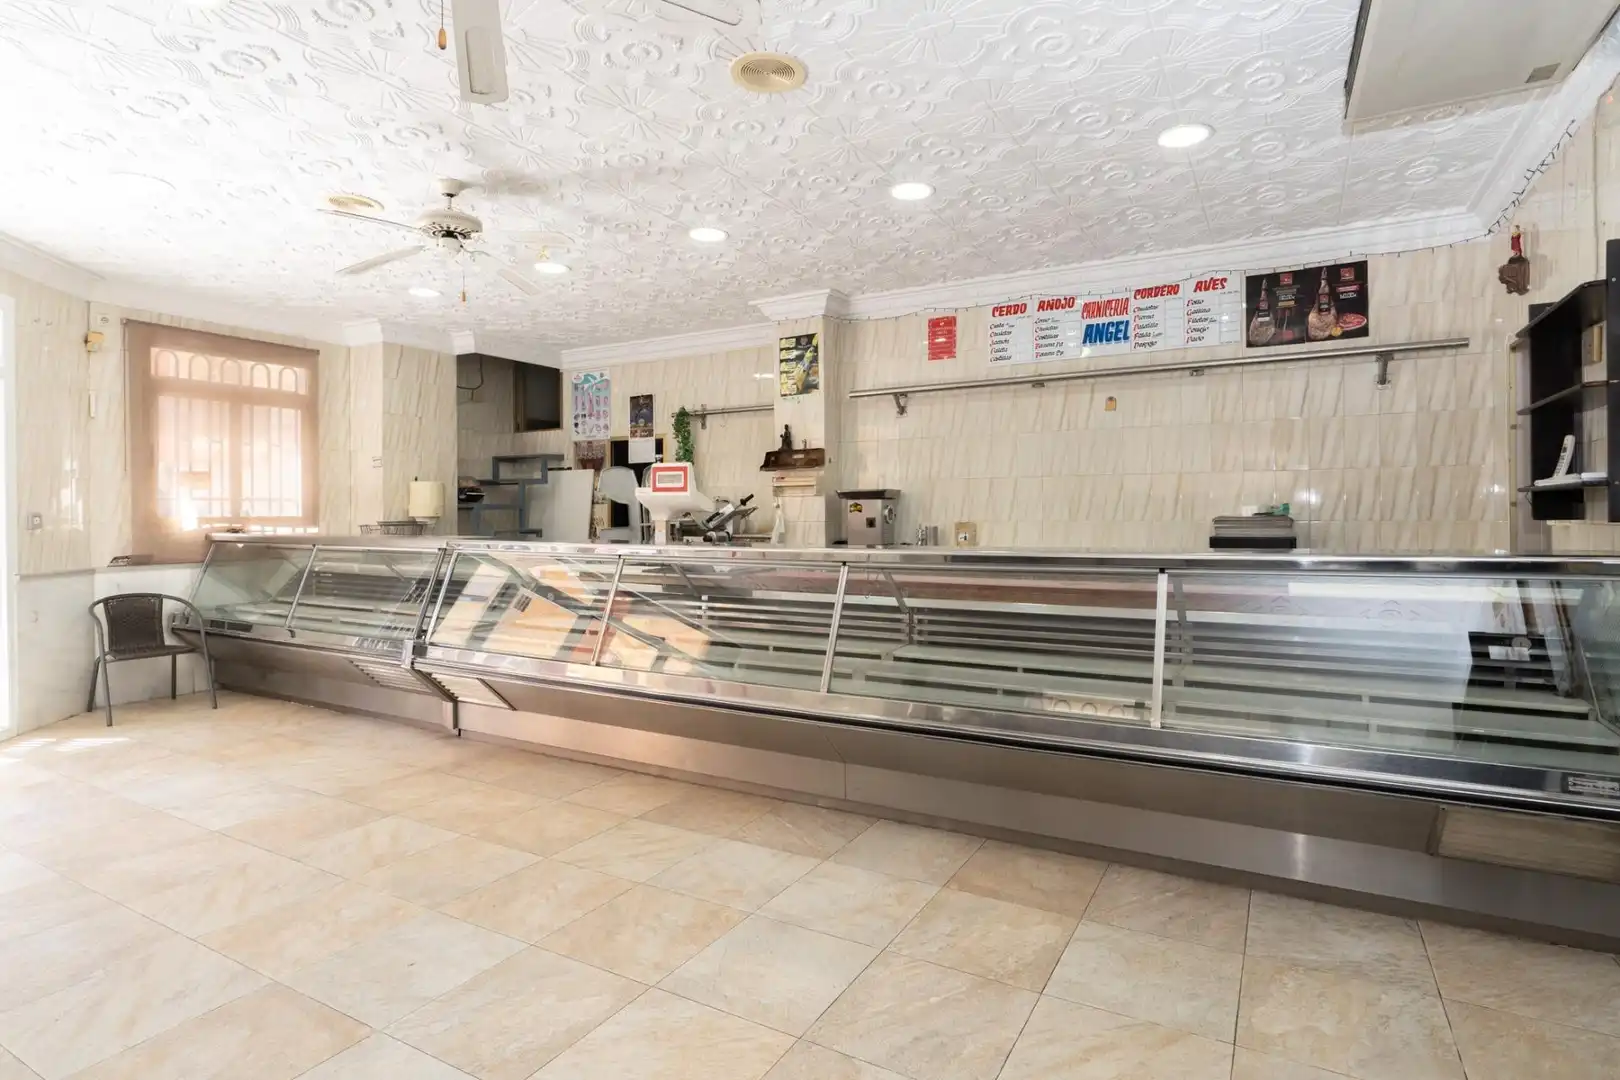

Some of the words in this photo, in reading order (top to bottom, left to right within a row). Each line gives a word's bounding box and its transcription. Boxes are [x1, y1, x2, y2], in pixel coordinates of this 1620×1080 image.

[1133, 283, 1180, 300] CORDERO
[1193, 277, 1228, 292] AVES
[991, 303, 1027, 318] CERDO
[1082, 320, 1130, 344] ANGEL
